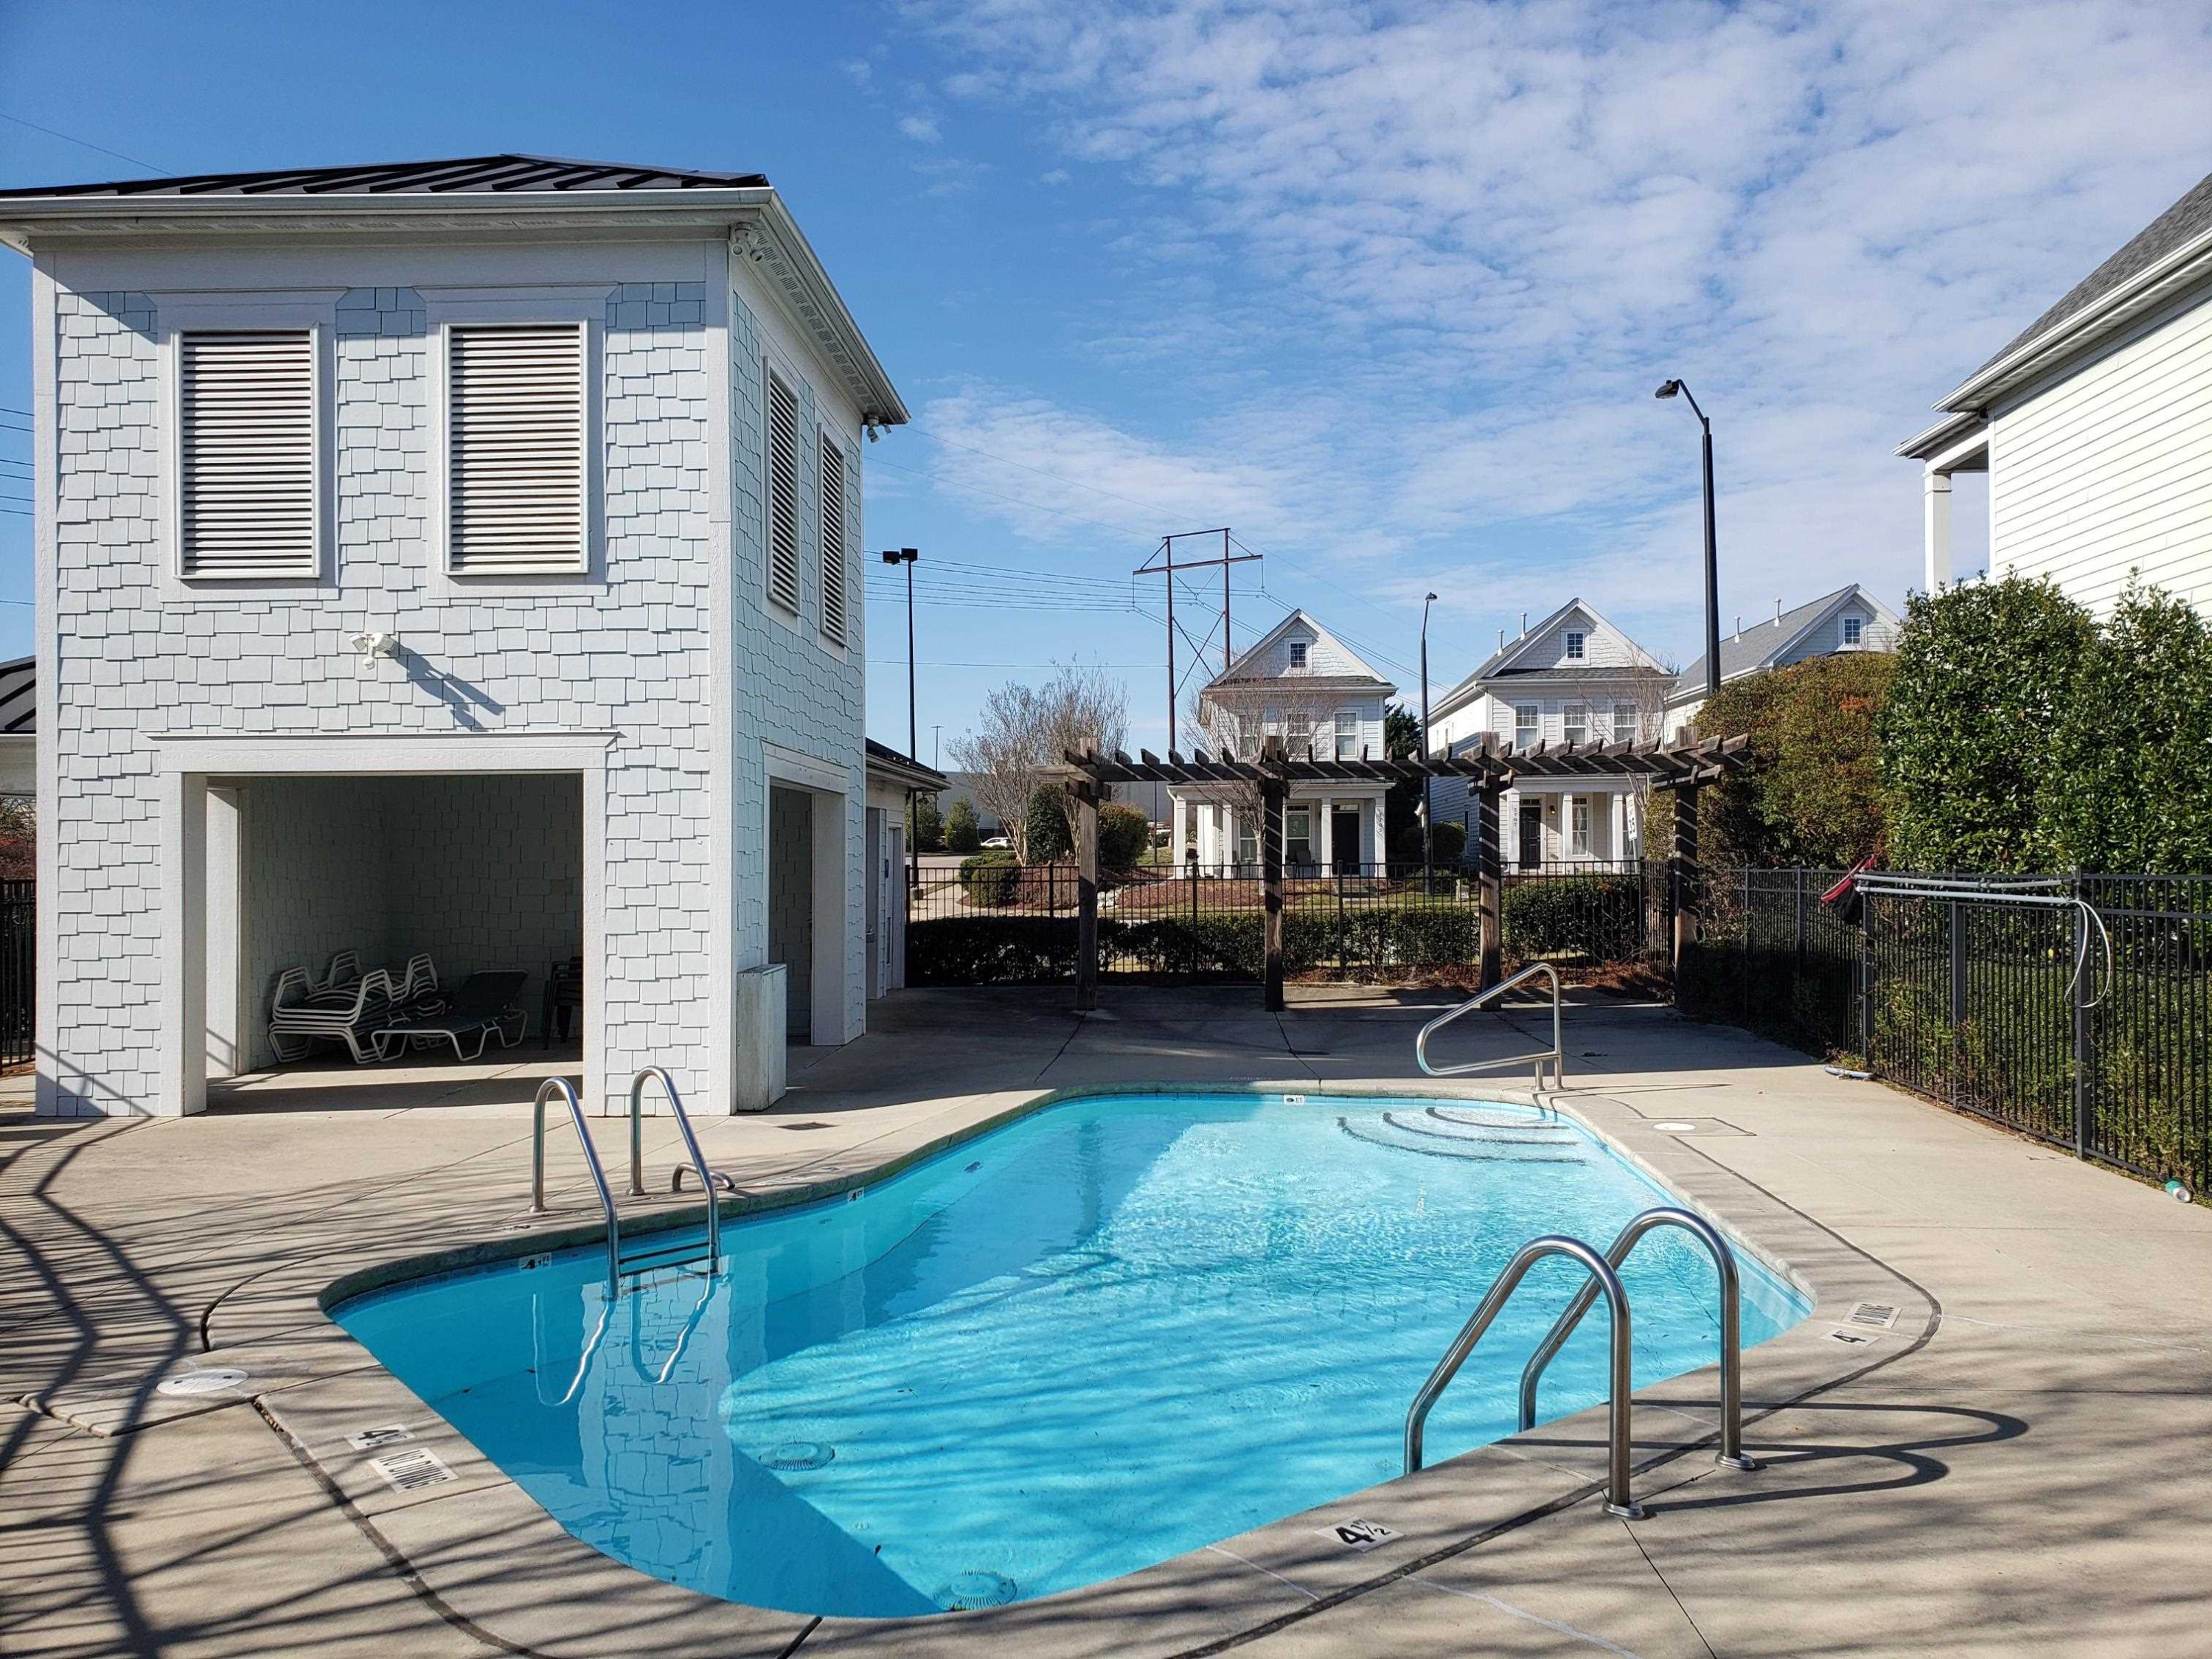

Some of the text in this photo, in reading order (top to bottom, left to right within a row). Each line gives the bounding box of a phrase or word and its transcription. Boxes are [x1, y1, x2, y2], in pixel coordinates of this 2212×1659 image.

[1832, 1334, 1867, 1343] 4
[358, 1430, 400, 1440] 4
[378, 1450, 449, 1489] NO DIVING
